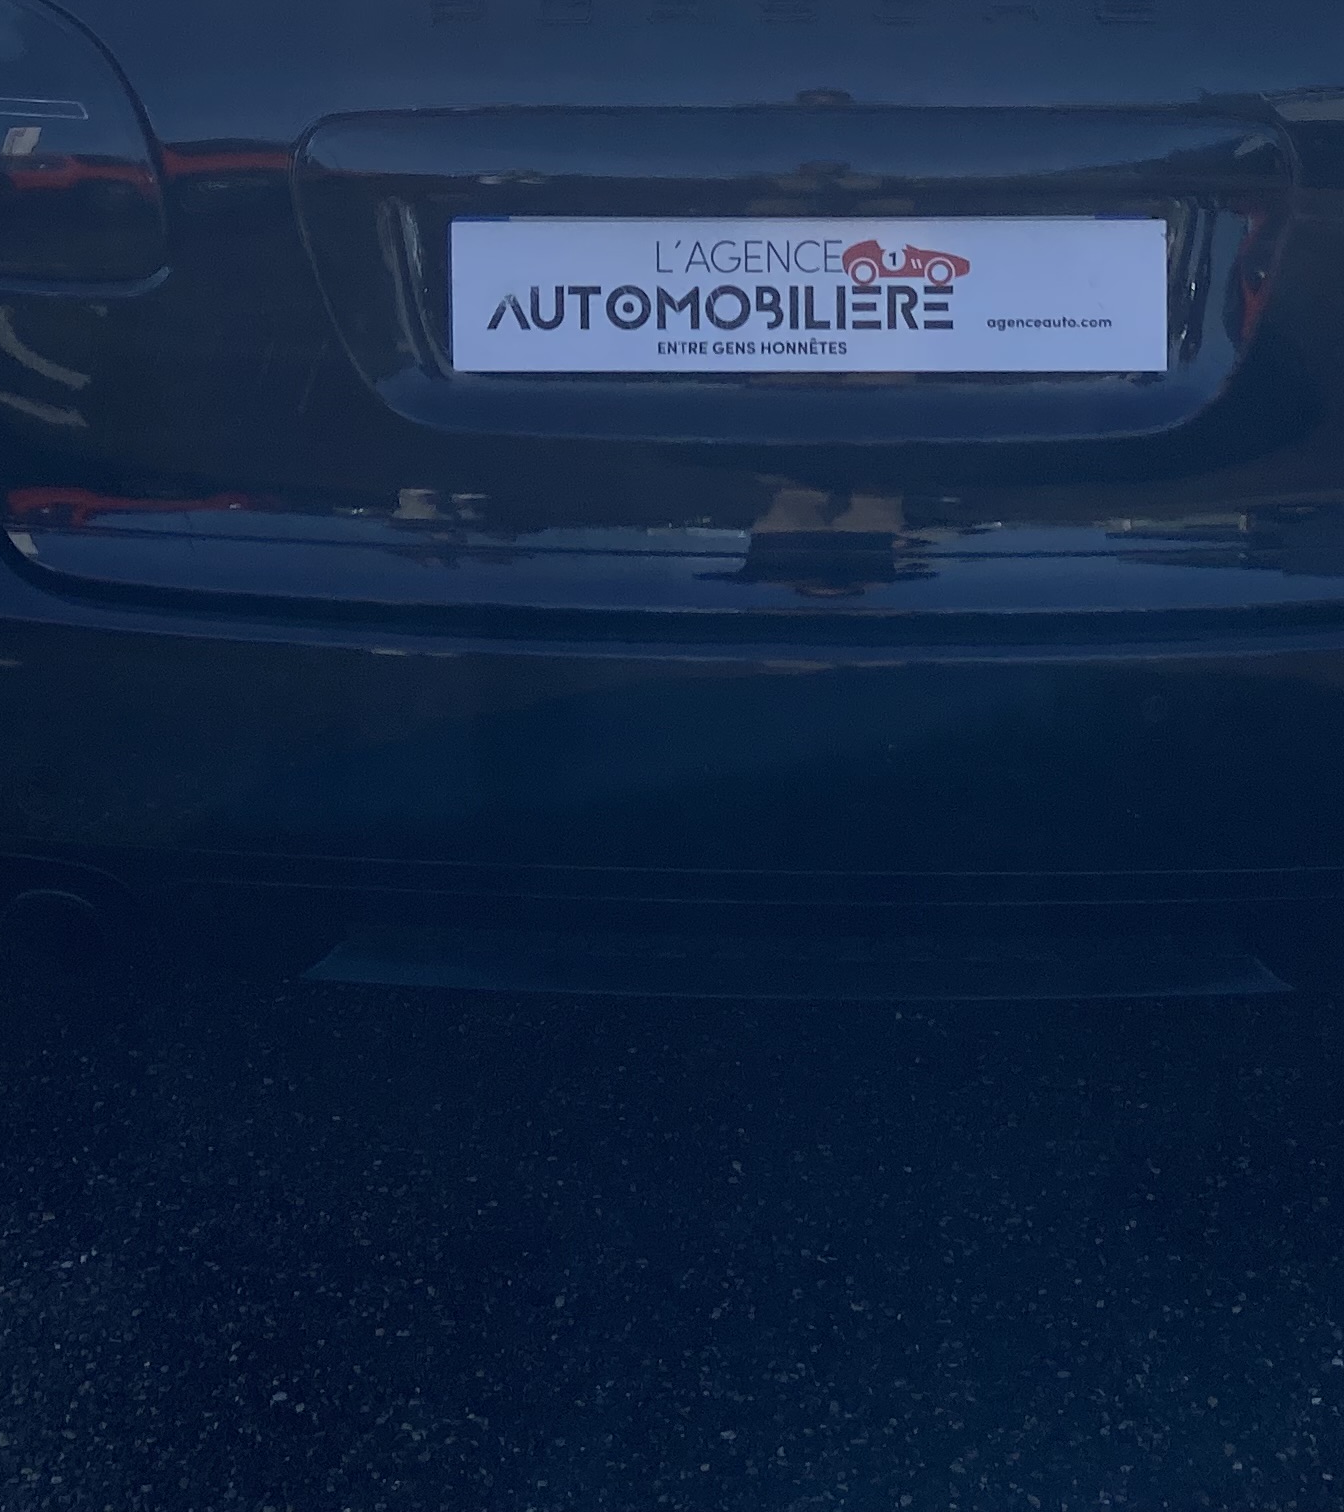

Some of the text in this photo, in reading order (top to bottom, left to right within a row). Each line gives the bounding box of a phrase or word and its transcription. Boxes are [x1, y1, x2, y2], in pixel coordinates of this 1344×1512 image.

[656, 239, 844, 274] L'AGENCE
[888, 251, 898, 267] 1
[986, 315, 1113, 330] agenceauto.com
[658, 337, 847, 356] ENTRE GENS HONNÊTES
